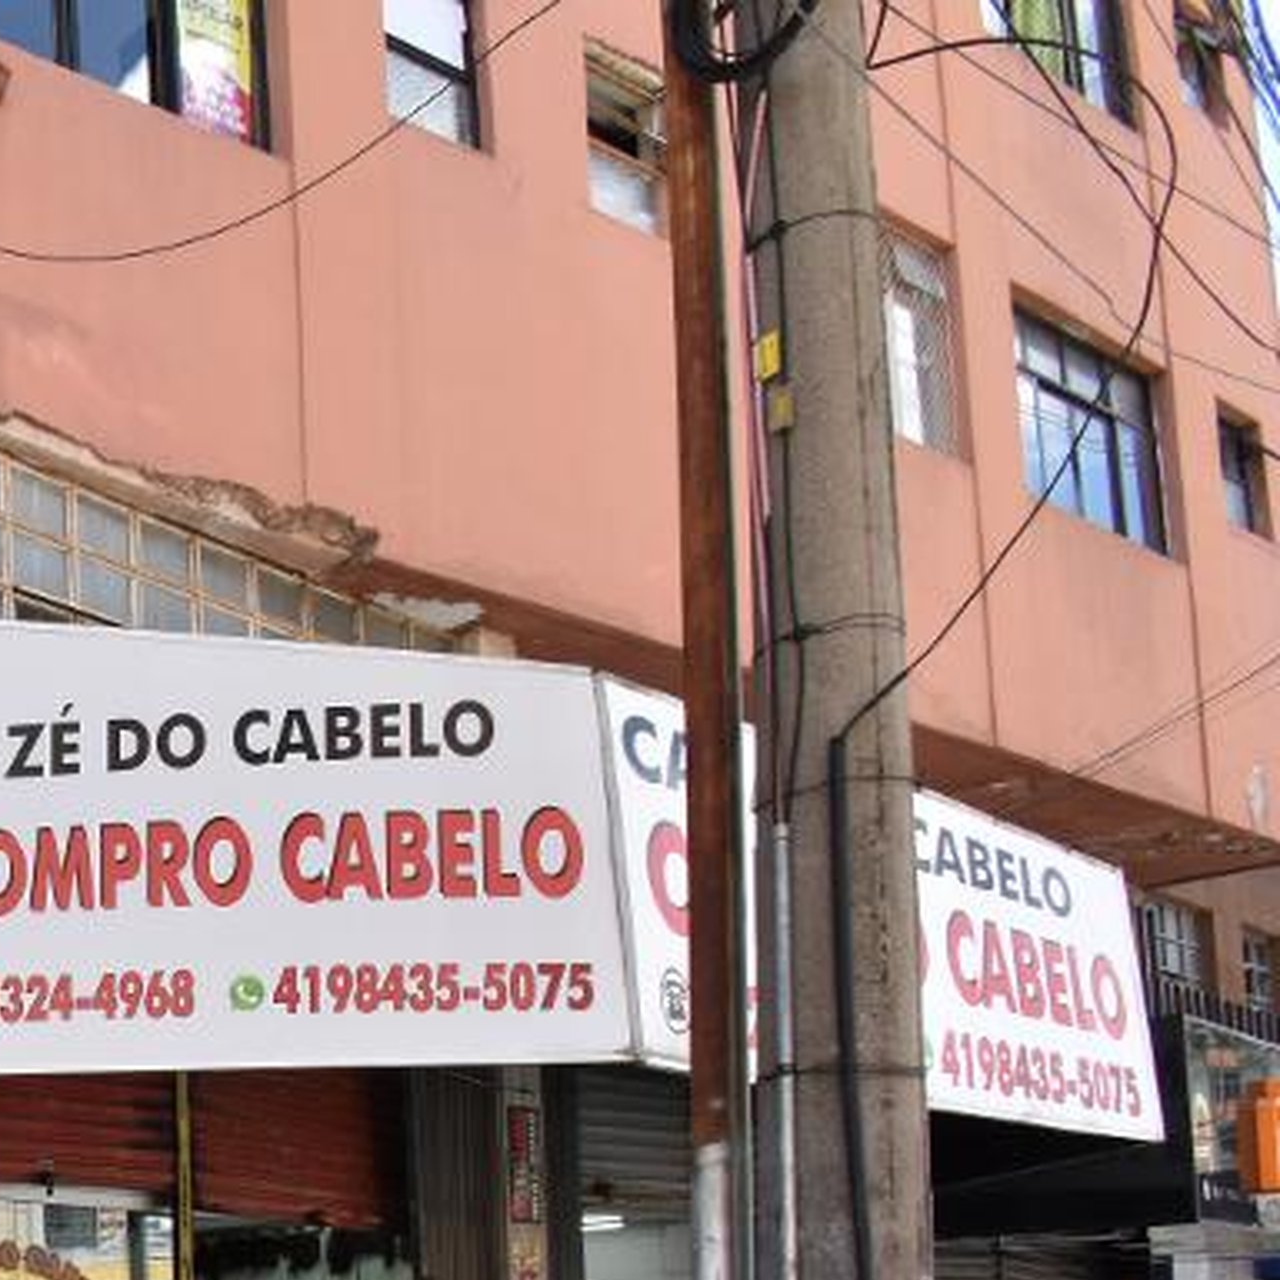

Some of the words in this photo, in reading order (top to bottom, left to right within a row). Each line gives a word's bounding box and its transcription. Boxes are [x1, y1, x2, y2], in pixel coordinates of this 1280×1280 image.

[4, 703, 81, 779] ZÉ
[106, 714, 207, 772] DO
[233, 699, 496, 766] CABELO
[278, 805, 585, 903] CABELO
[272, 962, 596, 1014] 4198435-5075
[946, 910, 1127, 1041] CABELO
[942, 1029, 1141, 1117] 4198435-5075
